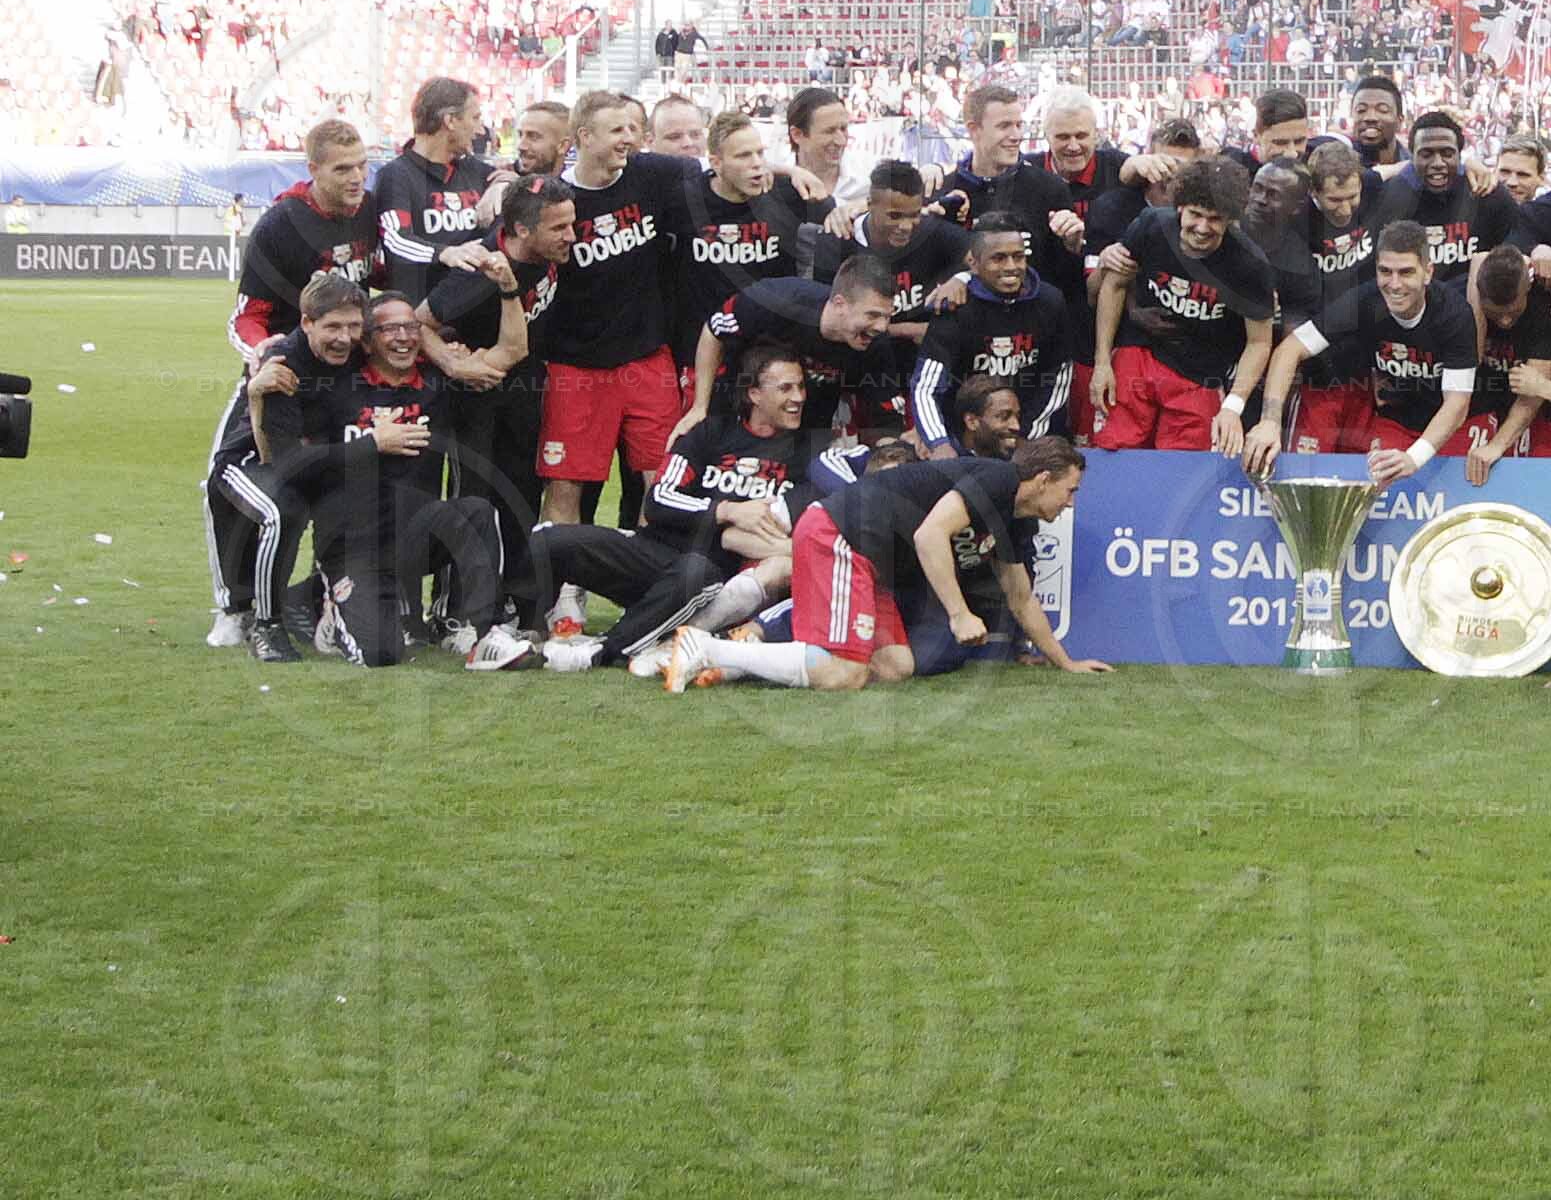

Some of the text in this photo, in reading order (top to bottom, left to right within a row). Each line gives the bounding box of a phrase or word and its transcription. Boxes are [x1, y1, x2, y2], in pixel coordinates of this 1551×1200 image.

[573, 215, 657, 268] DOUBLE
[692, 235, 780, 265] DOUBLE
[16, 244, 241, 272] BRINGT DAS TEAM
[701, 463, 795, 499] DOUBLE
[1368, 490, 1445, 520] EAM
[1105, 527, 1200, 577] ÖFB
[1228, 597, 1298, 627] 201
[1456, 623, 1500, 641] LIGA
